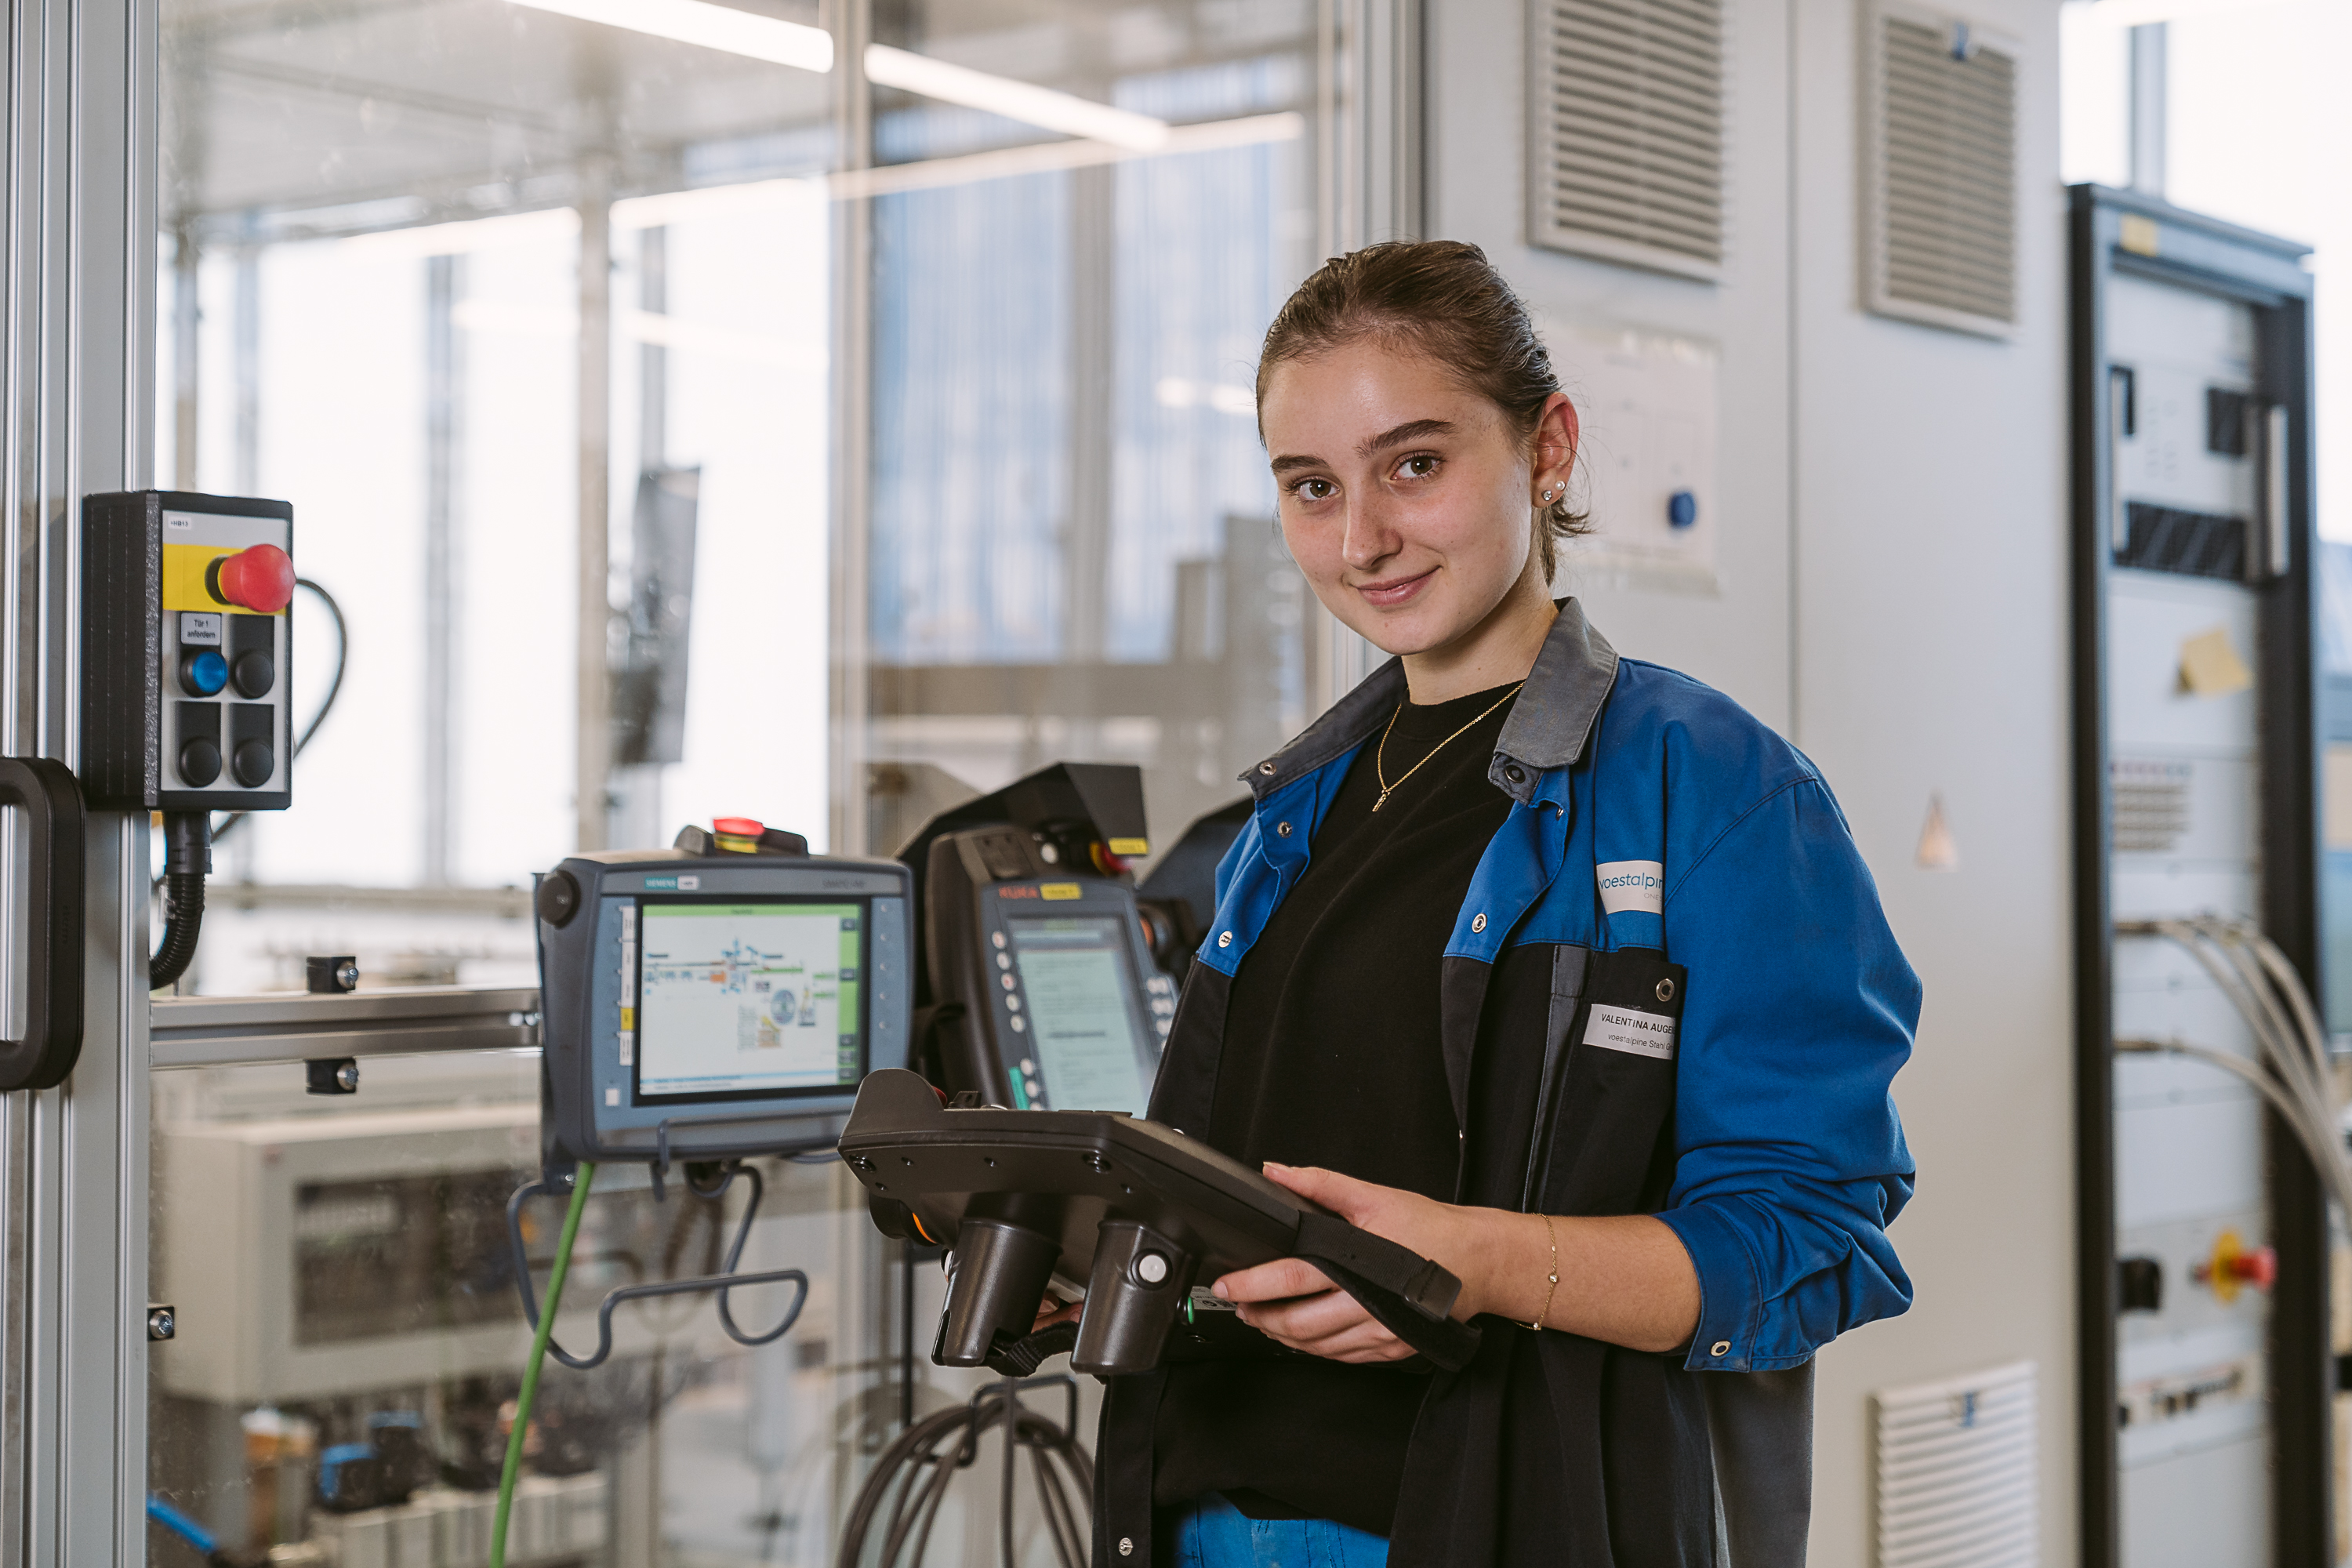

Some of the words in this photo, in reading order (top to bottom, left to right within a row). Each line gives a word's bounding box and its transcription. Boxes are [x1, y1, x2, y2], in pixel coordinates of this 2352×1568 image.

[194, 619, 204, 627] Tür
[187, 630, 216, 638] anfordern
[999, 886, 1038, 899] KUKA
[1602, 1014, 1648, 1030] VALENTINA
[1608, 1034, 1647, 1047] voestalpine
[1649, 1040, 1665, 1050] Stahl
